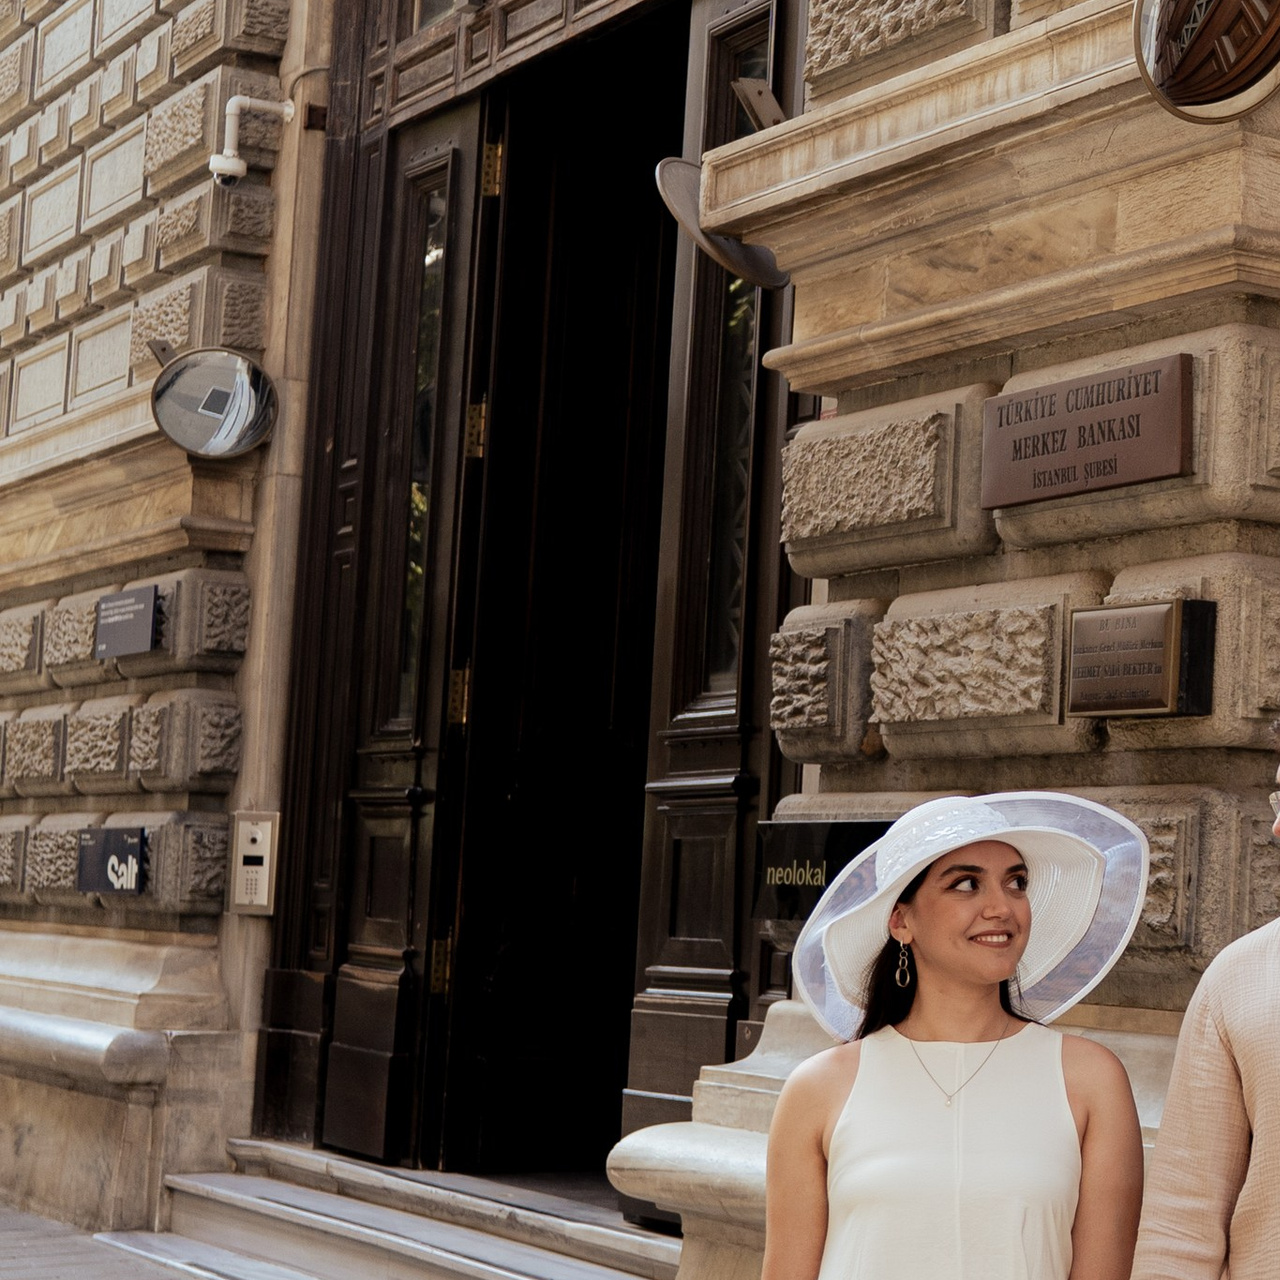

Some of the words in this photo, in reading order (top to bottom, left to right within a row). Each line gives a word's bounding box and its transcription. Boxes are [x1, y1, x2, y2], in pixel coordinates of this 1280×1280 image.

[997, 391, 1057, 428] TÜRKİYE
[1066, 369, 1162, 413] CUMHURİYET
[1012, 429, 1067, 462] MERKEZ
[1077, 413, 1141, 449] BANKASI
[1032, 465, 1079, 489] İSTANBUL
[1083, 454, 1118, 486] ŞUBESİ
[766, 860, 826, 887] neolokal
